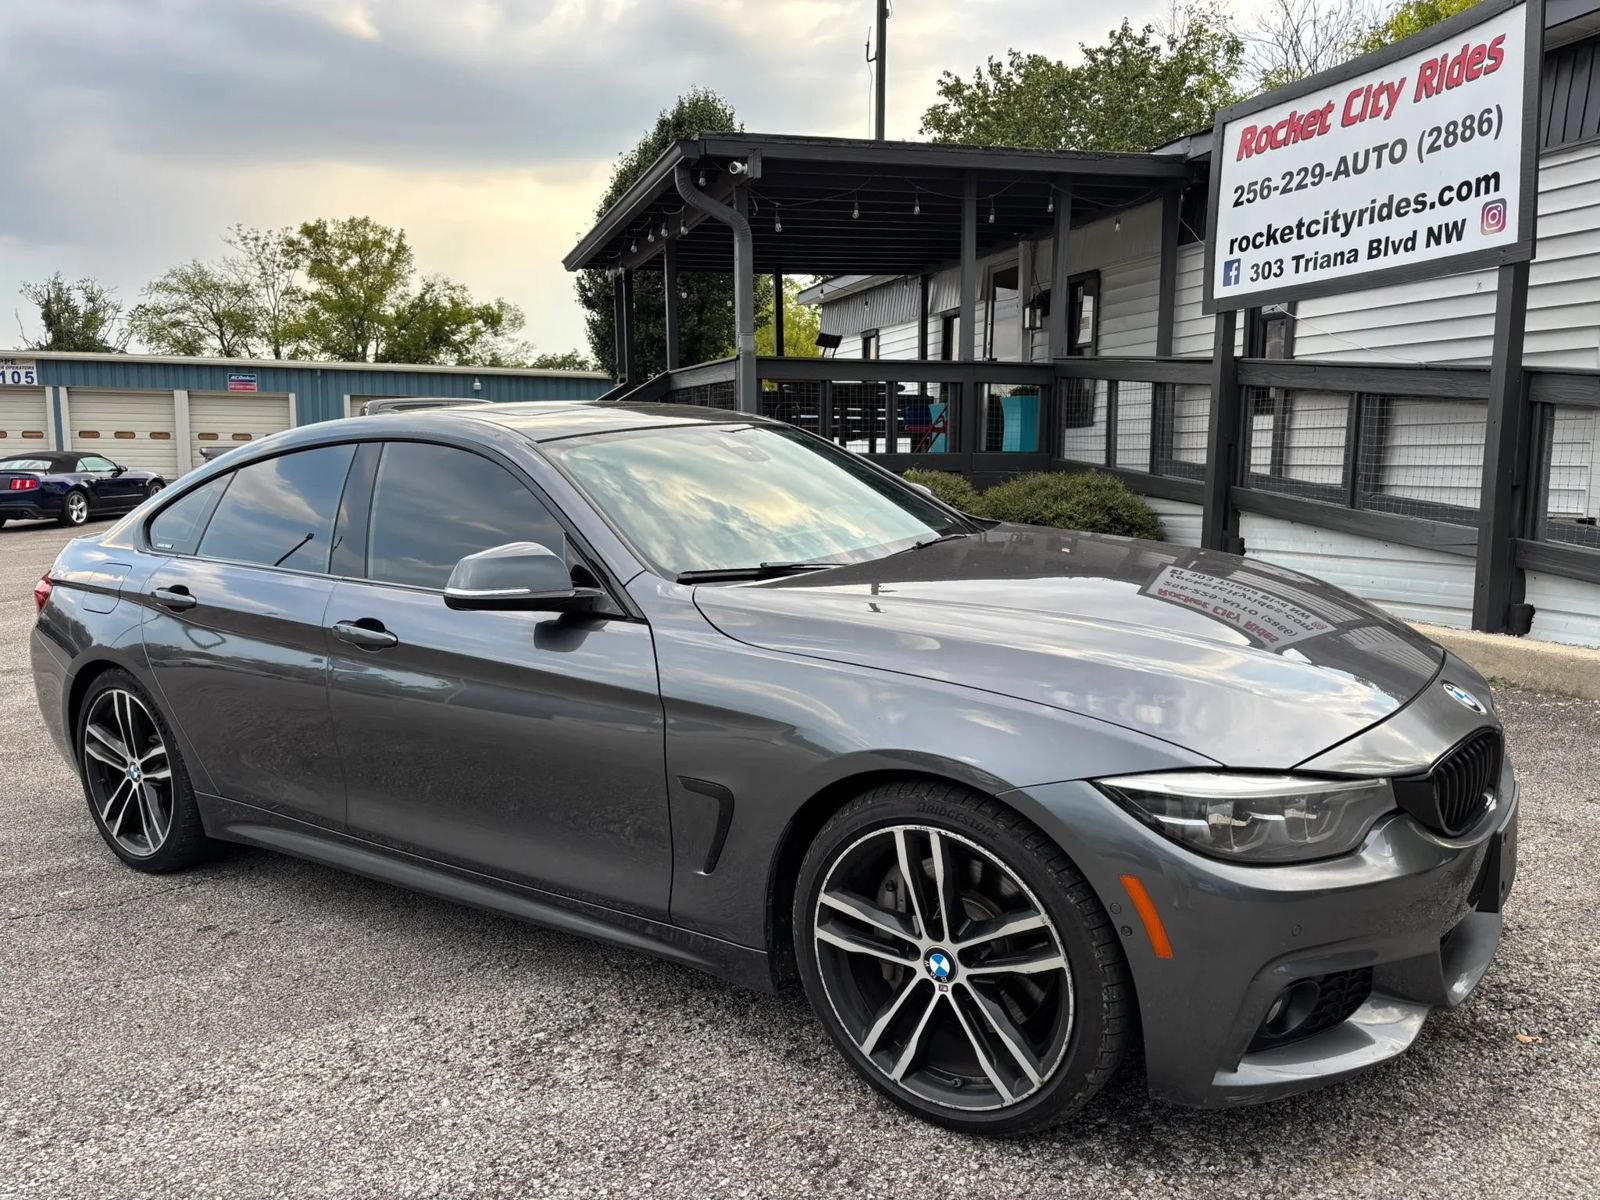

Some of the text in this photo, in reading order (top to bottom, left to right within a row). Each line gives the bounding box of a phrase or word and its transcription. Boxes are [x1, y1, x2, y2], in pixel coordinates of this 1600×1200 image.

[1236, 33, 1506, 162] Rocket City Rides
[1233, 104, 1504, 208] 256-229-AUTO (2886)
[1228, 170, 1501, 255] rocketcityrides.com
[1250, 259, 1285, 283] 303
[1291, 247, 1359, 275] Triana
[1367, 229, 1417, 261] Blvd
[1425, 219, 1467, 249] NW
[917, 802, 1001, 841] BRIDGESTONE
